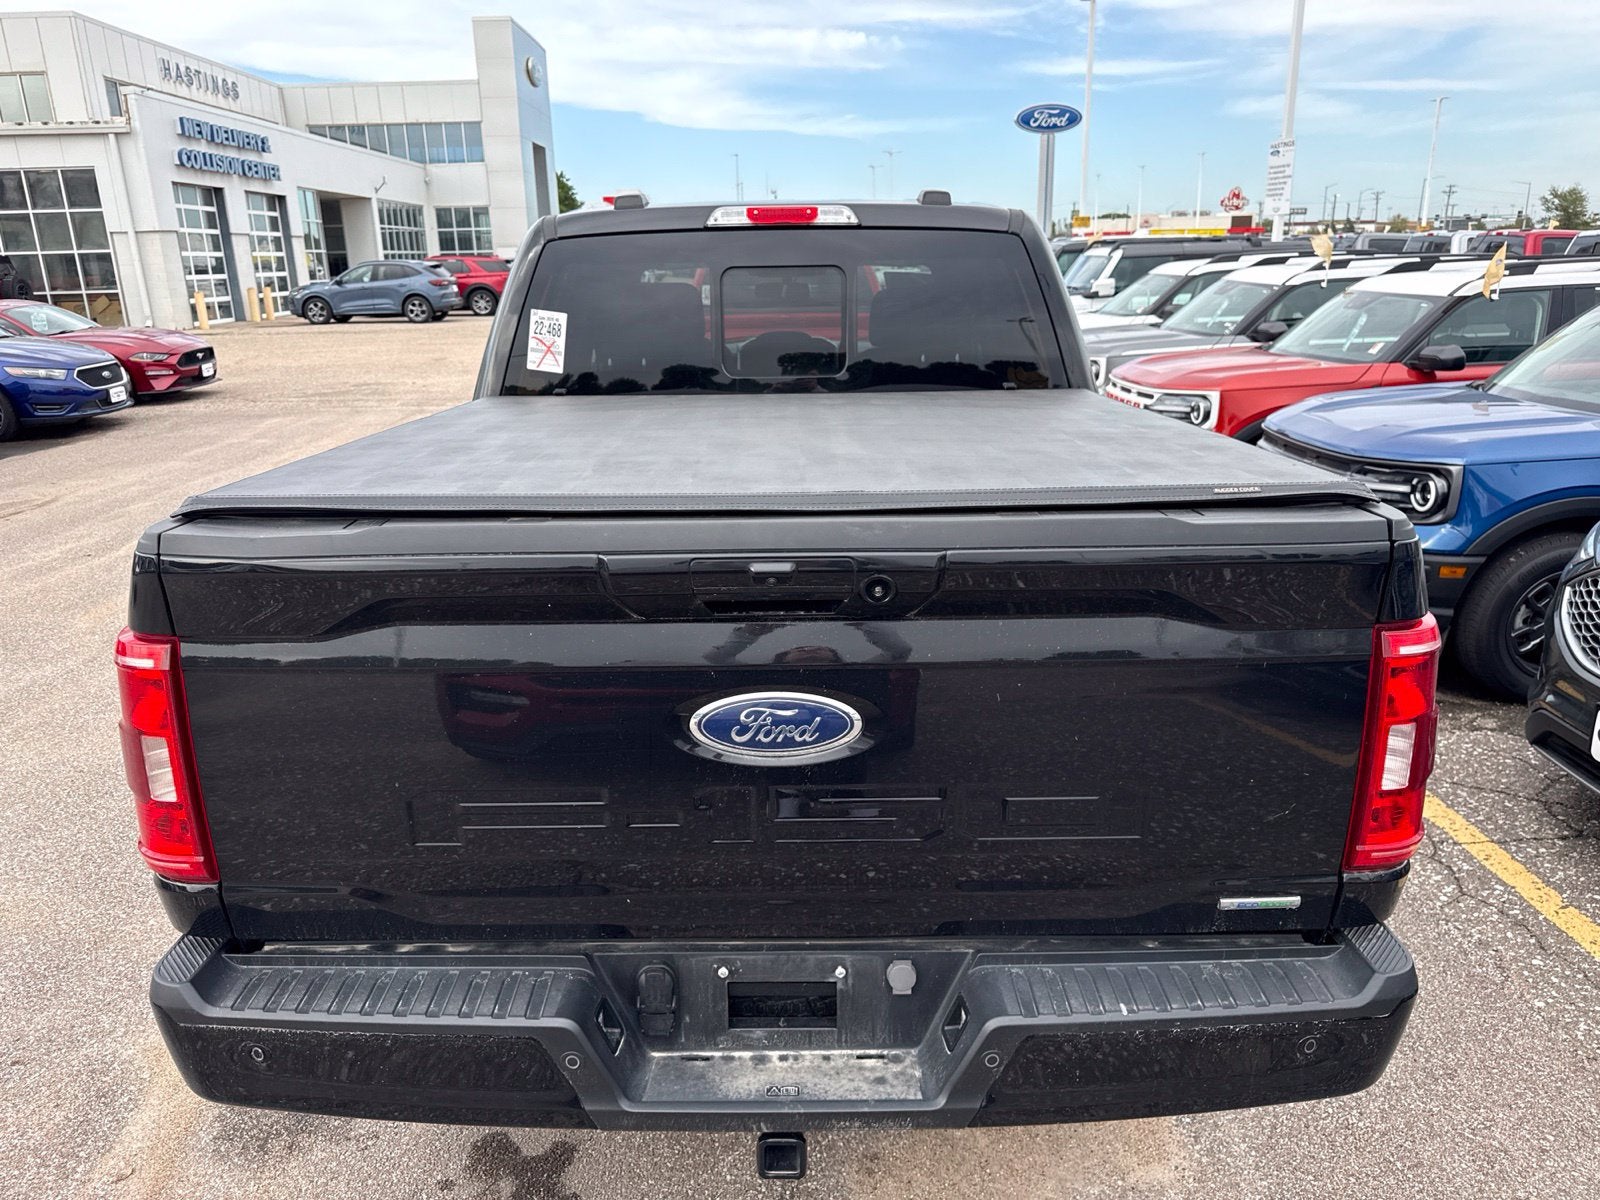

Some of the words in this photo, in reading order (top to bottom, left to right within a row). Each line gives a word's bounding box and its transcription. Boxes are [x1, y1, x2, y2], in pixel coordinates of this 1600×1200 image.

[161, 58, 240, 101] HASTINGS
[179, 116, 211, 141] NEW
[210, 124, 262, 152] DELIVERY
[1029, 109, 1070, 127] Ford
[178, 147, 243, 176] COLLISION
[240, 159, 281, 181] CENTER
[730, 707, 822, 743] Ford
